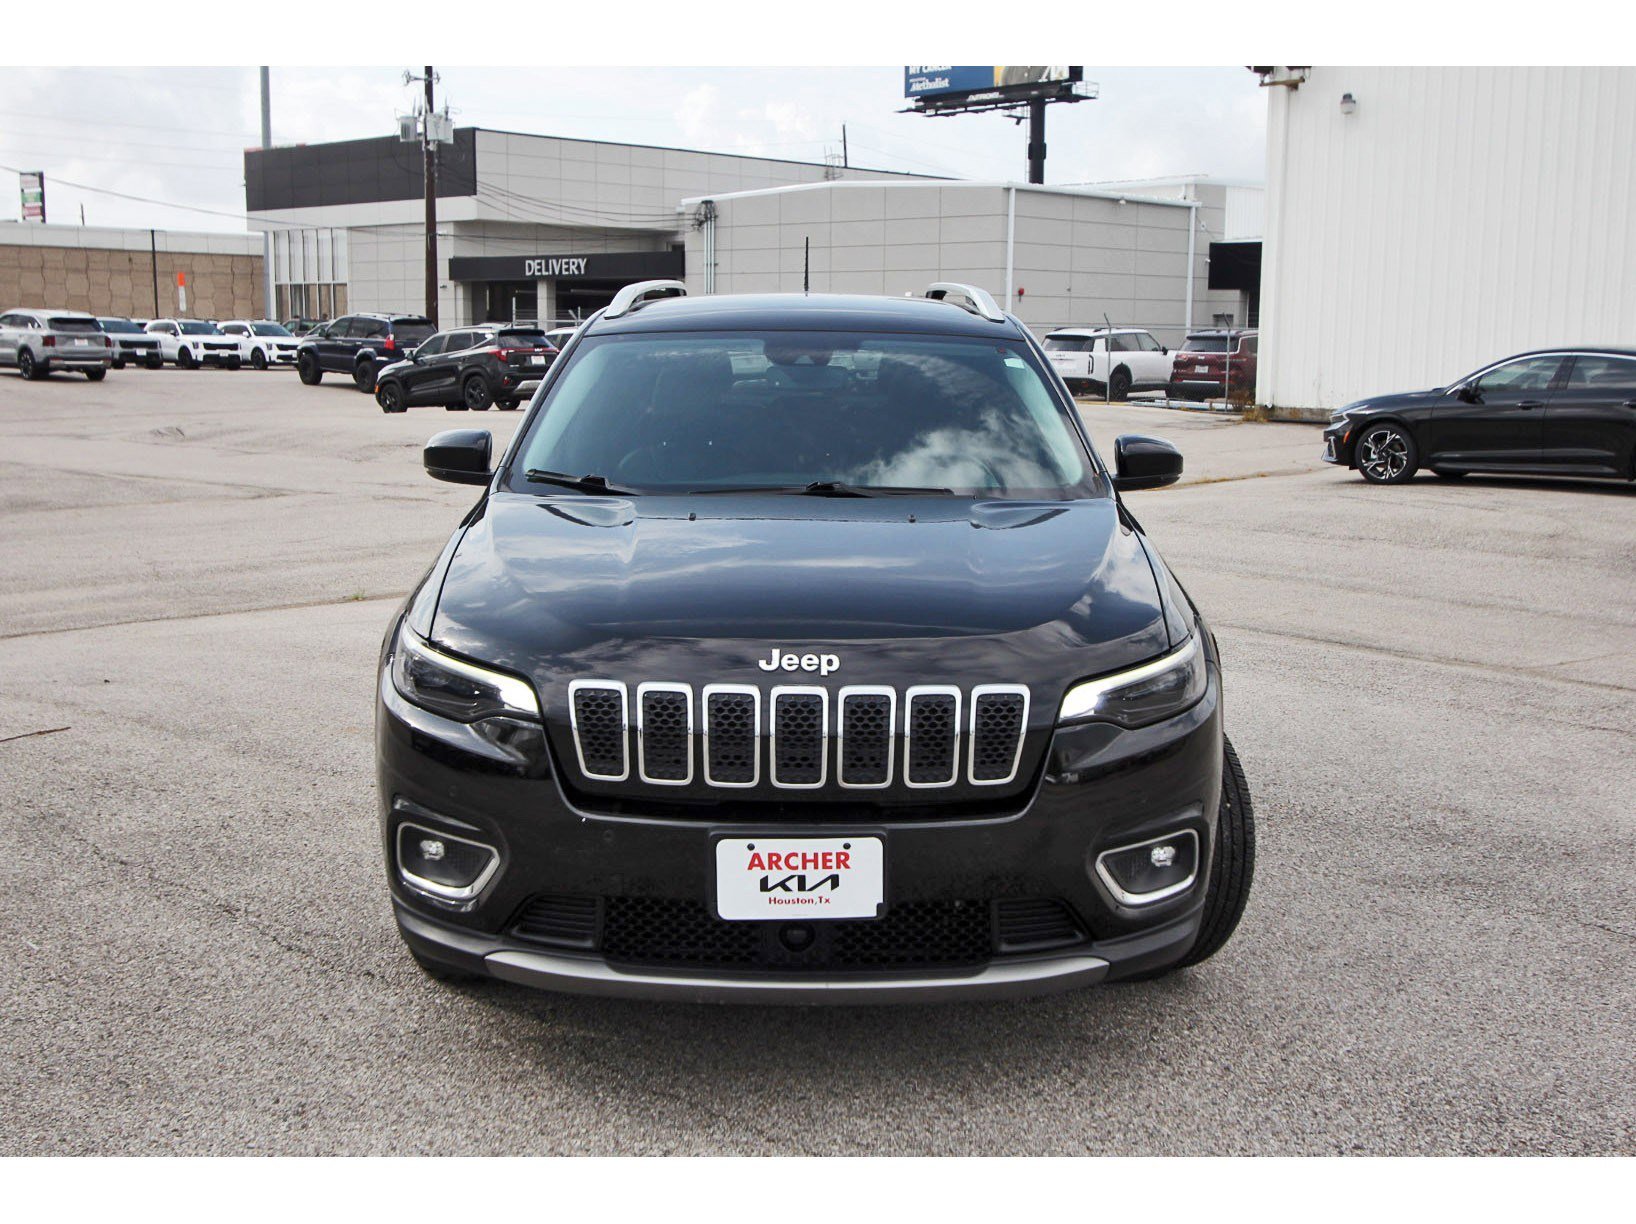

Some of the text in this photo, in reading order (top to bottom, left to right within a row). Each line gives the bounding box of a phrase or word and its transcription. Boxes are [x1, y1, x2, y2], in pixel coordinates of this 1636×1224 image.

[525, 258, 587, 276] DELIVERY
[758, 648, 840, 676] Jeep
[747, 852, 851, 871] ARCHER
